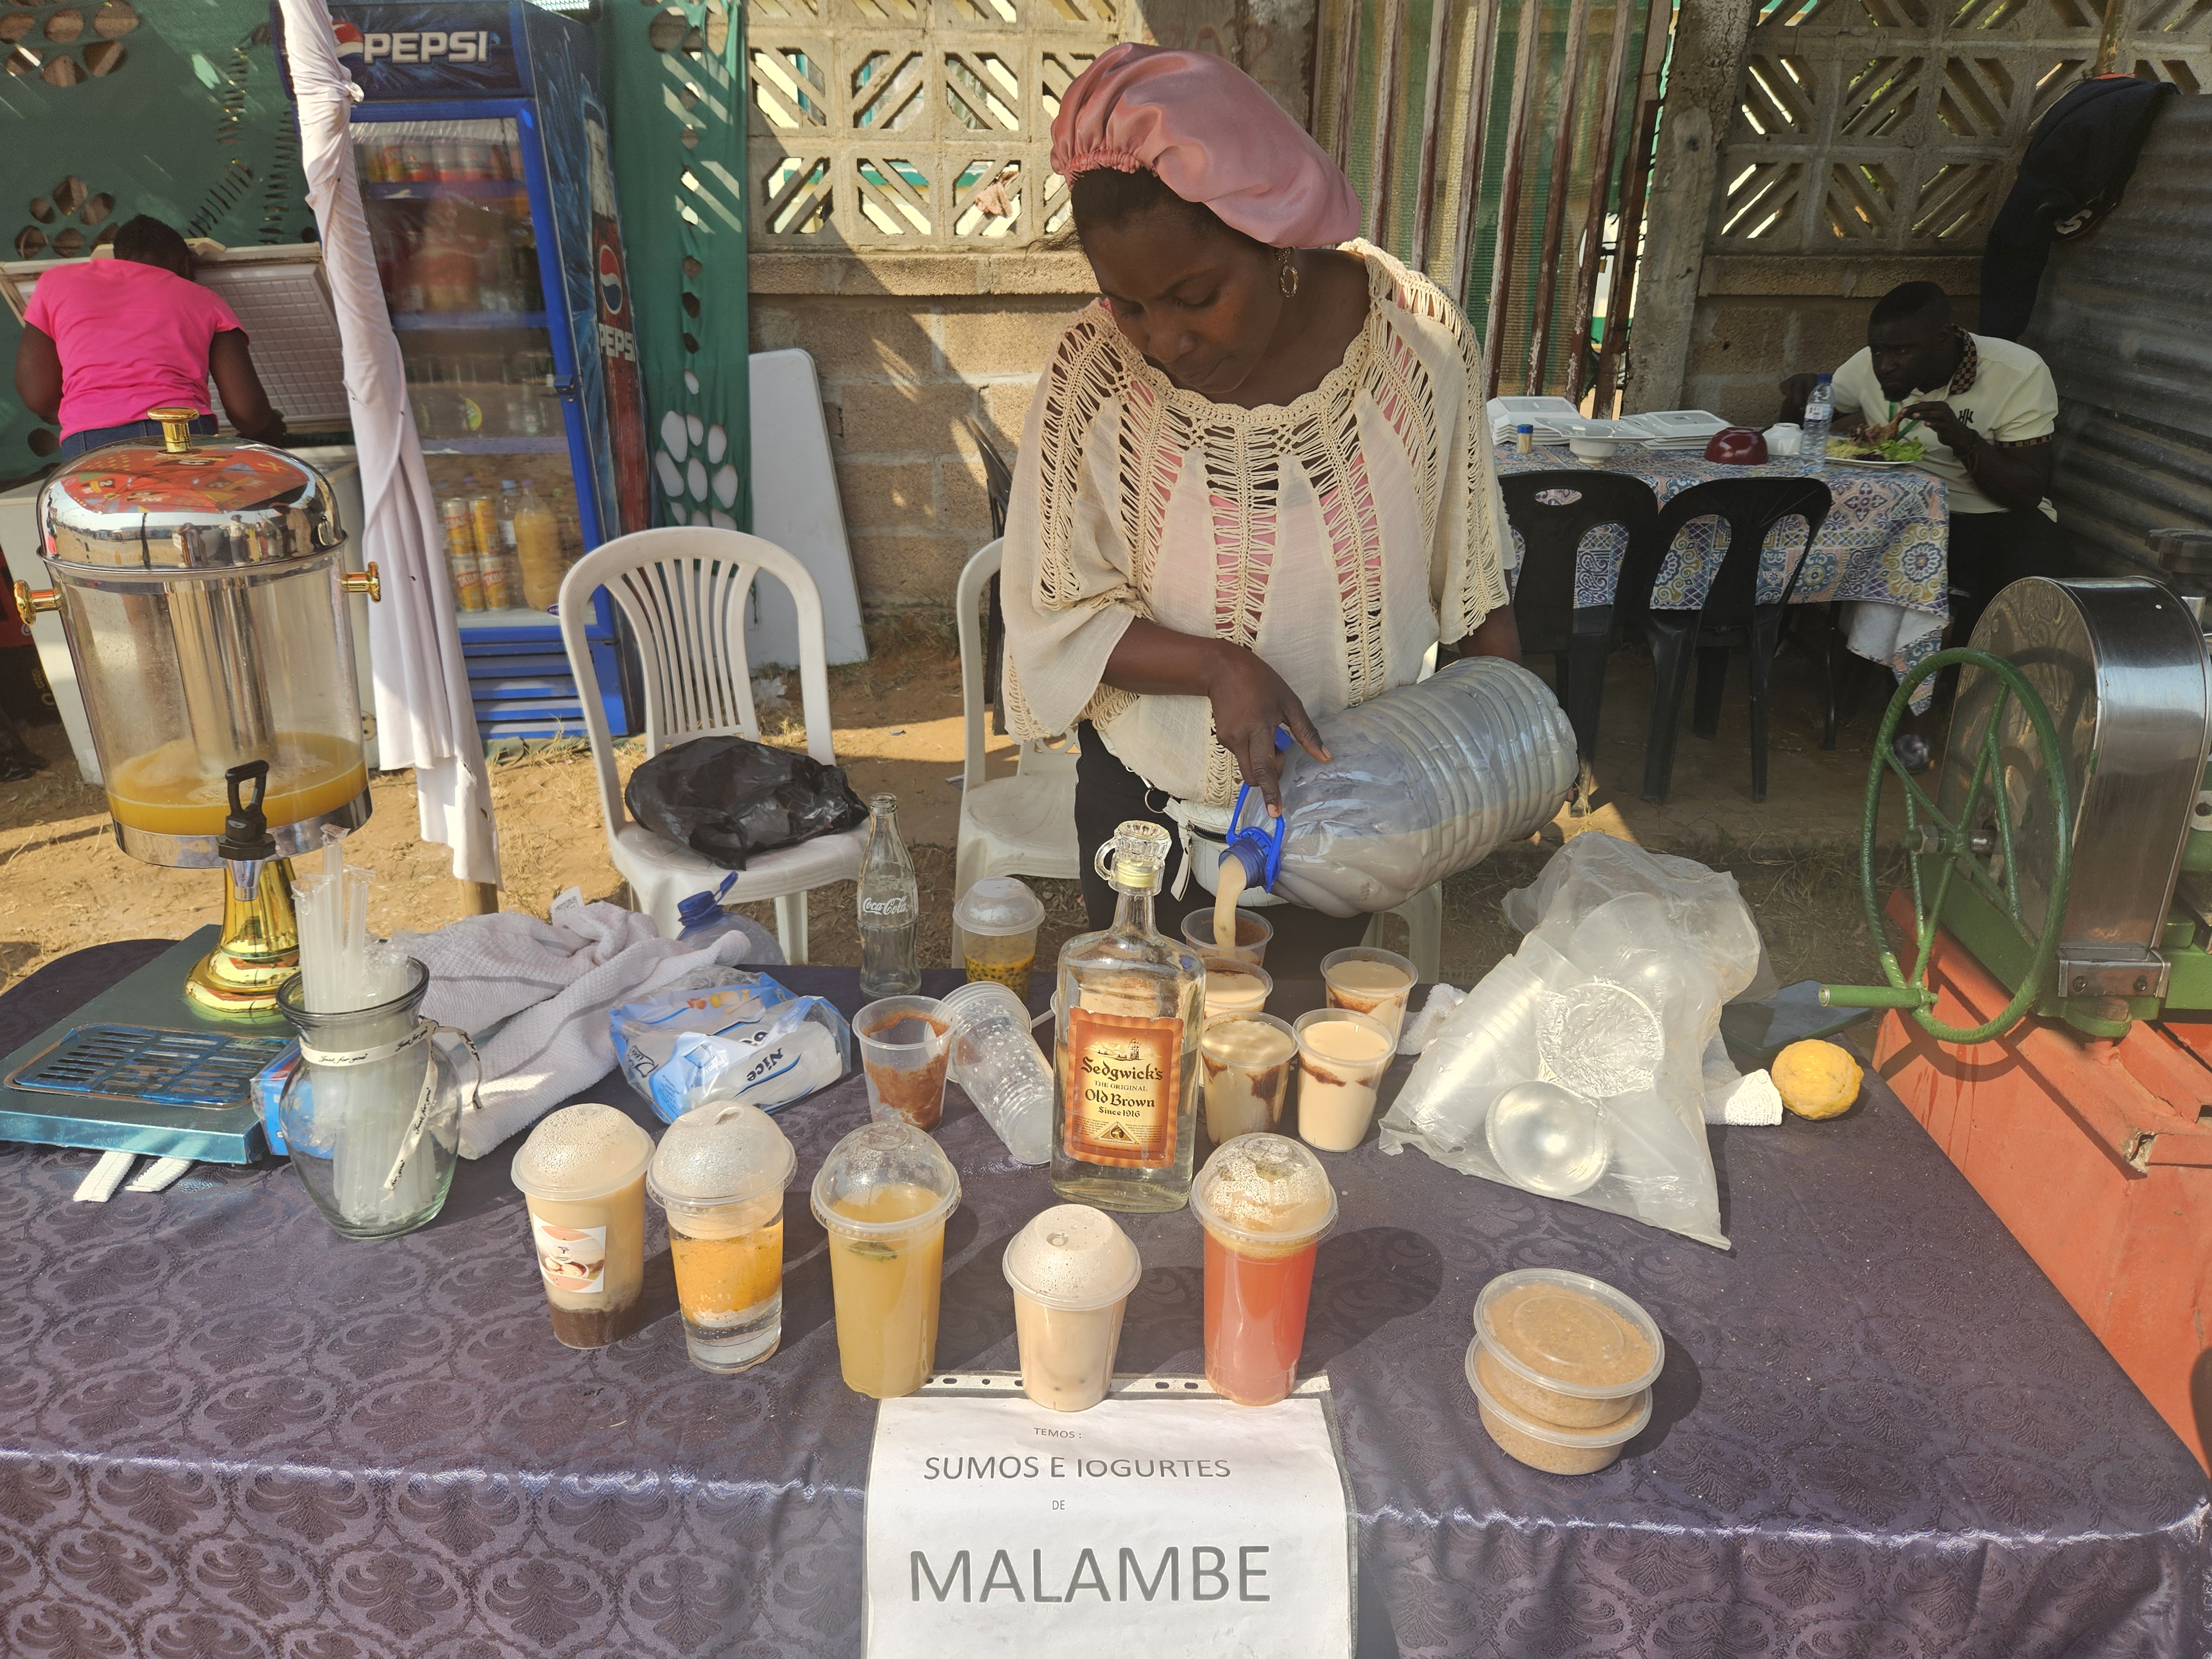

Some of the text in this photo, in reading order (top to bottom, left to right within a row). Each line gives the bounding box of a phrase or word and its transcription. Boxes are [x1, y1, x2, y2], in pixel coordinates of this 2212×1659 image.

[363, 31, 488, 64] PEPSI
[747, 1047, 784, 1081] Nice
[1081, 1056, 1164, 1081] Sedgwick's
[1094, 1080, 1147, 1092] THE ORIGINAL
[1085, 1088, 1155, 1108] Old Brown
[1098, 1106, 1140, 1118] Since 1916
[1033, 1427, 1076, 1439] TEMOS
[924, 1456, 1232, 1480] SUMOS E IOGURTES
[1052, 1500, 1066, 1511] DE
[910, 1545, 1271, 1603] MALAMBE
